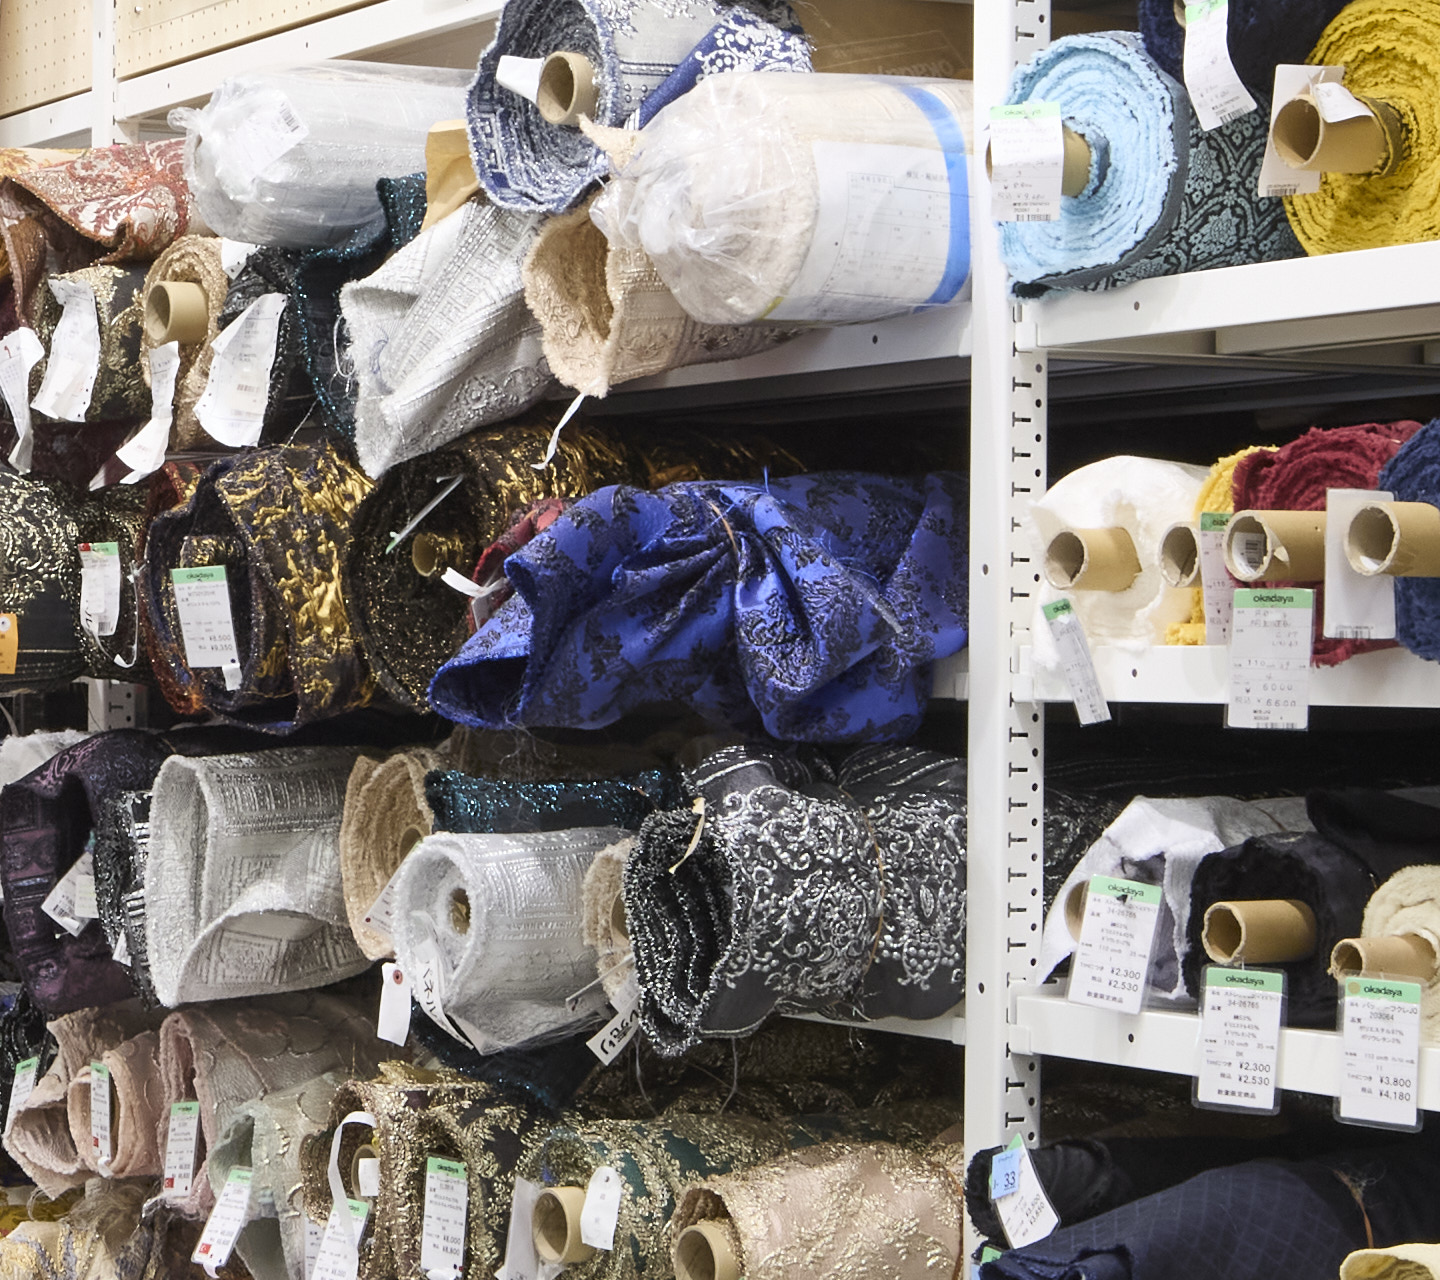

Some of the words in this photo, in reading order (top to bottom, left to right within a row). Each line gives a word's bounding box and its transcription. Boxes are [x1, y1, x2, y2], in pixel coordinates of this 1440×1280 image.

[1253, 594, 1293, 604] okadaya
[1108, 884, 1144, 898] okadaya
[1226, 974, 1265, 986] okadaya
[1364, 985, 1402, 997] okadaya
